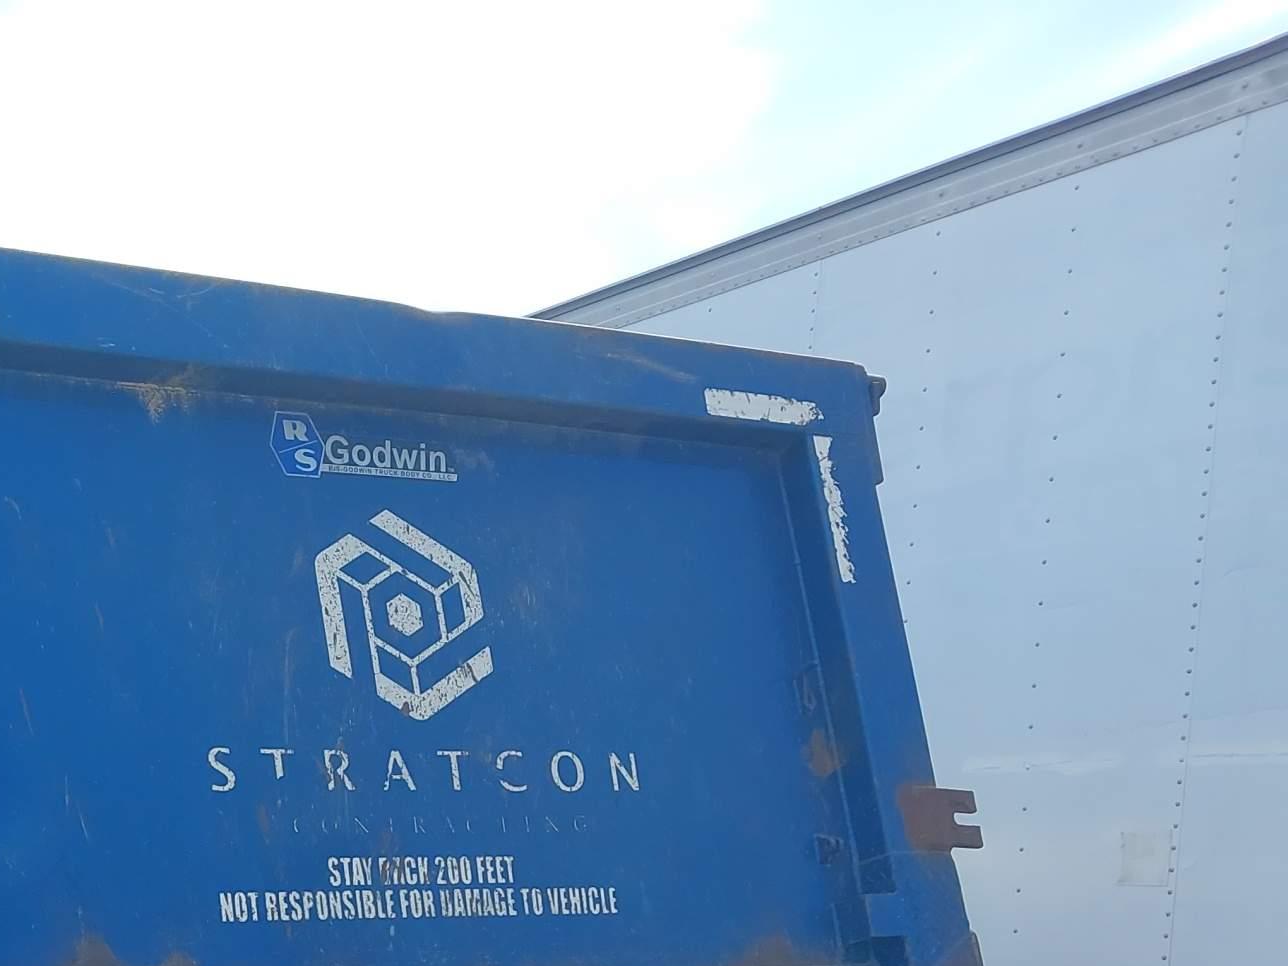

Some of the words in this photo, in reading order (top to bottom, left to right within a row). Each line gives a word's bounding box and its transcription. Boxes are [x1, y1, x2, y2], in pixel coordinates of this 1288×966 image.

[282, 419, 309, 441] R
[294, 448, 317, 472] S
[325, 434, 447, 473] Godwin
[375, 468, 398, 477] TRUCK
[400, 470, 420, 479] BODY
[207, 746, 641, 793] STRATCON
[328, 856, 372, 887] STAY
[434, 856, 473, 885] 200
[475, 855, 515, 884] FEET
[219, 891, 260, 922] NOT
[264, 889, 396, 922] RESPONSIBLE
[399, 888, 436, 919] FOR
[439, 887, 518, 918] DAMAGE
[520, 887, 544, 916] TO
[547, 886, 619, 916] VEHICLE
